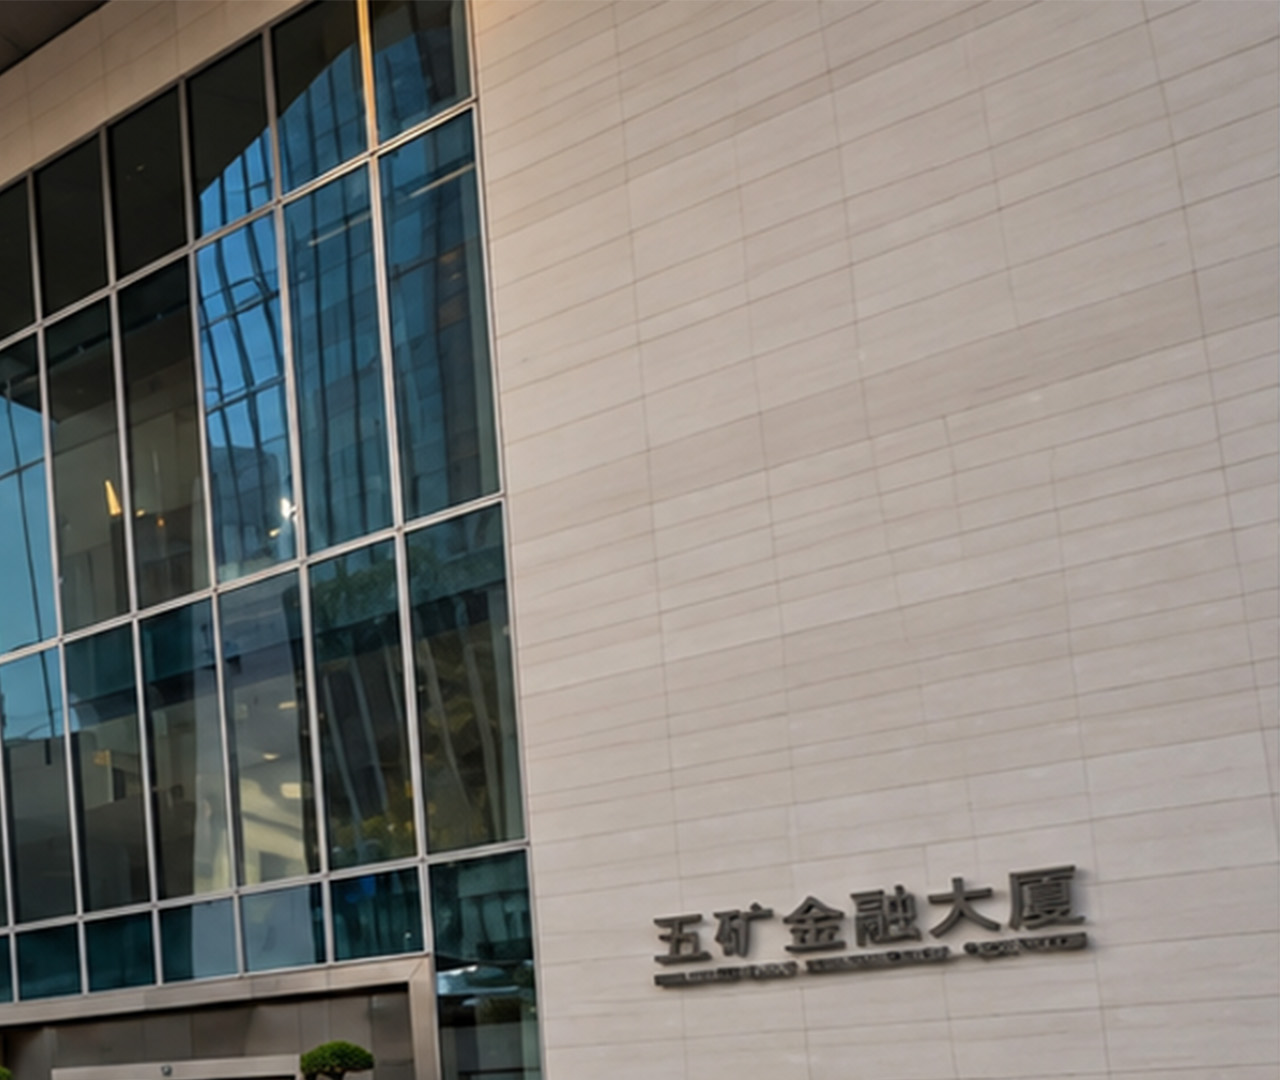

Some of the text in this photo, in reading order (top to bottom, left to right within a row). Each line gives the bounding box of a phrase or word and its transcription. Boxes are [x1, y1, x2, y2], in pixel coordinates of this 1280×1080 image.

[653, 865, 1086, 965] 五矿金融大厦
